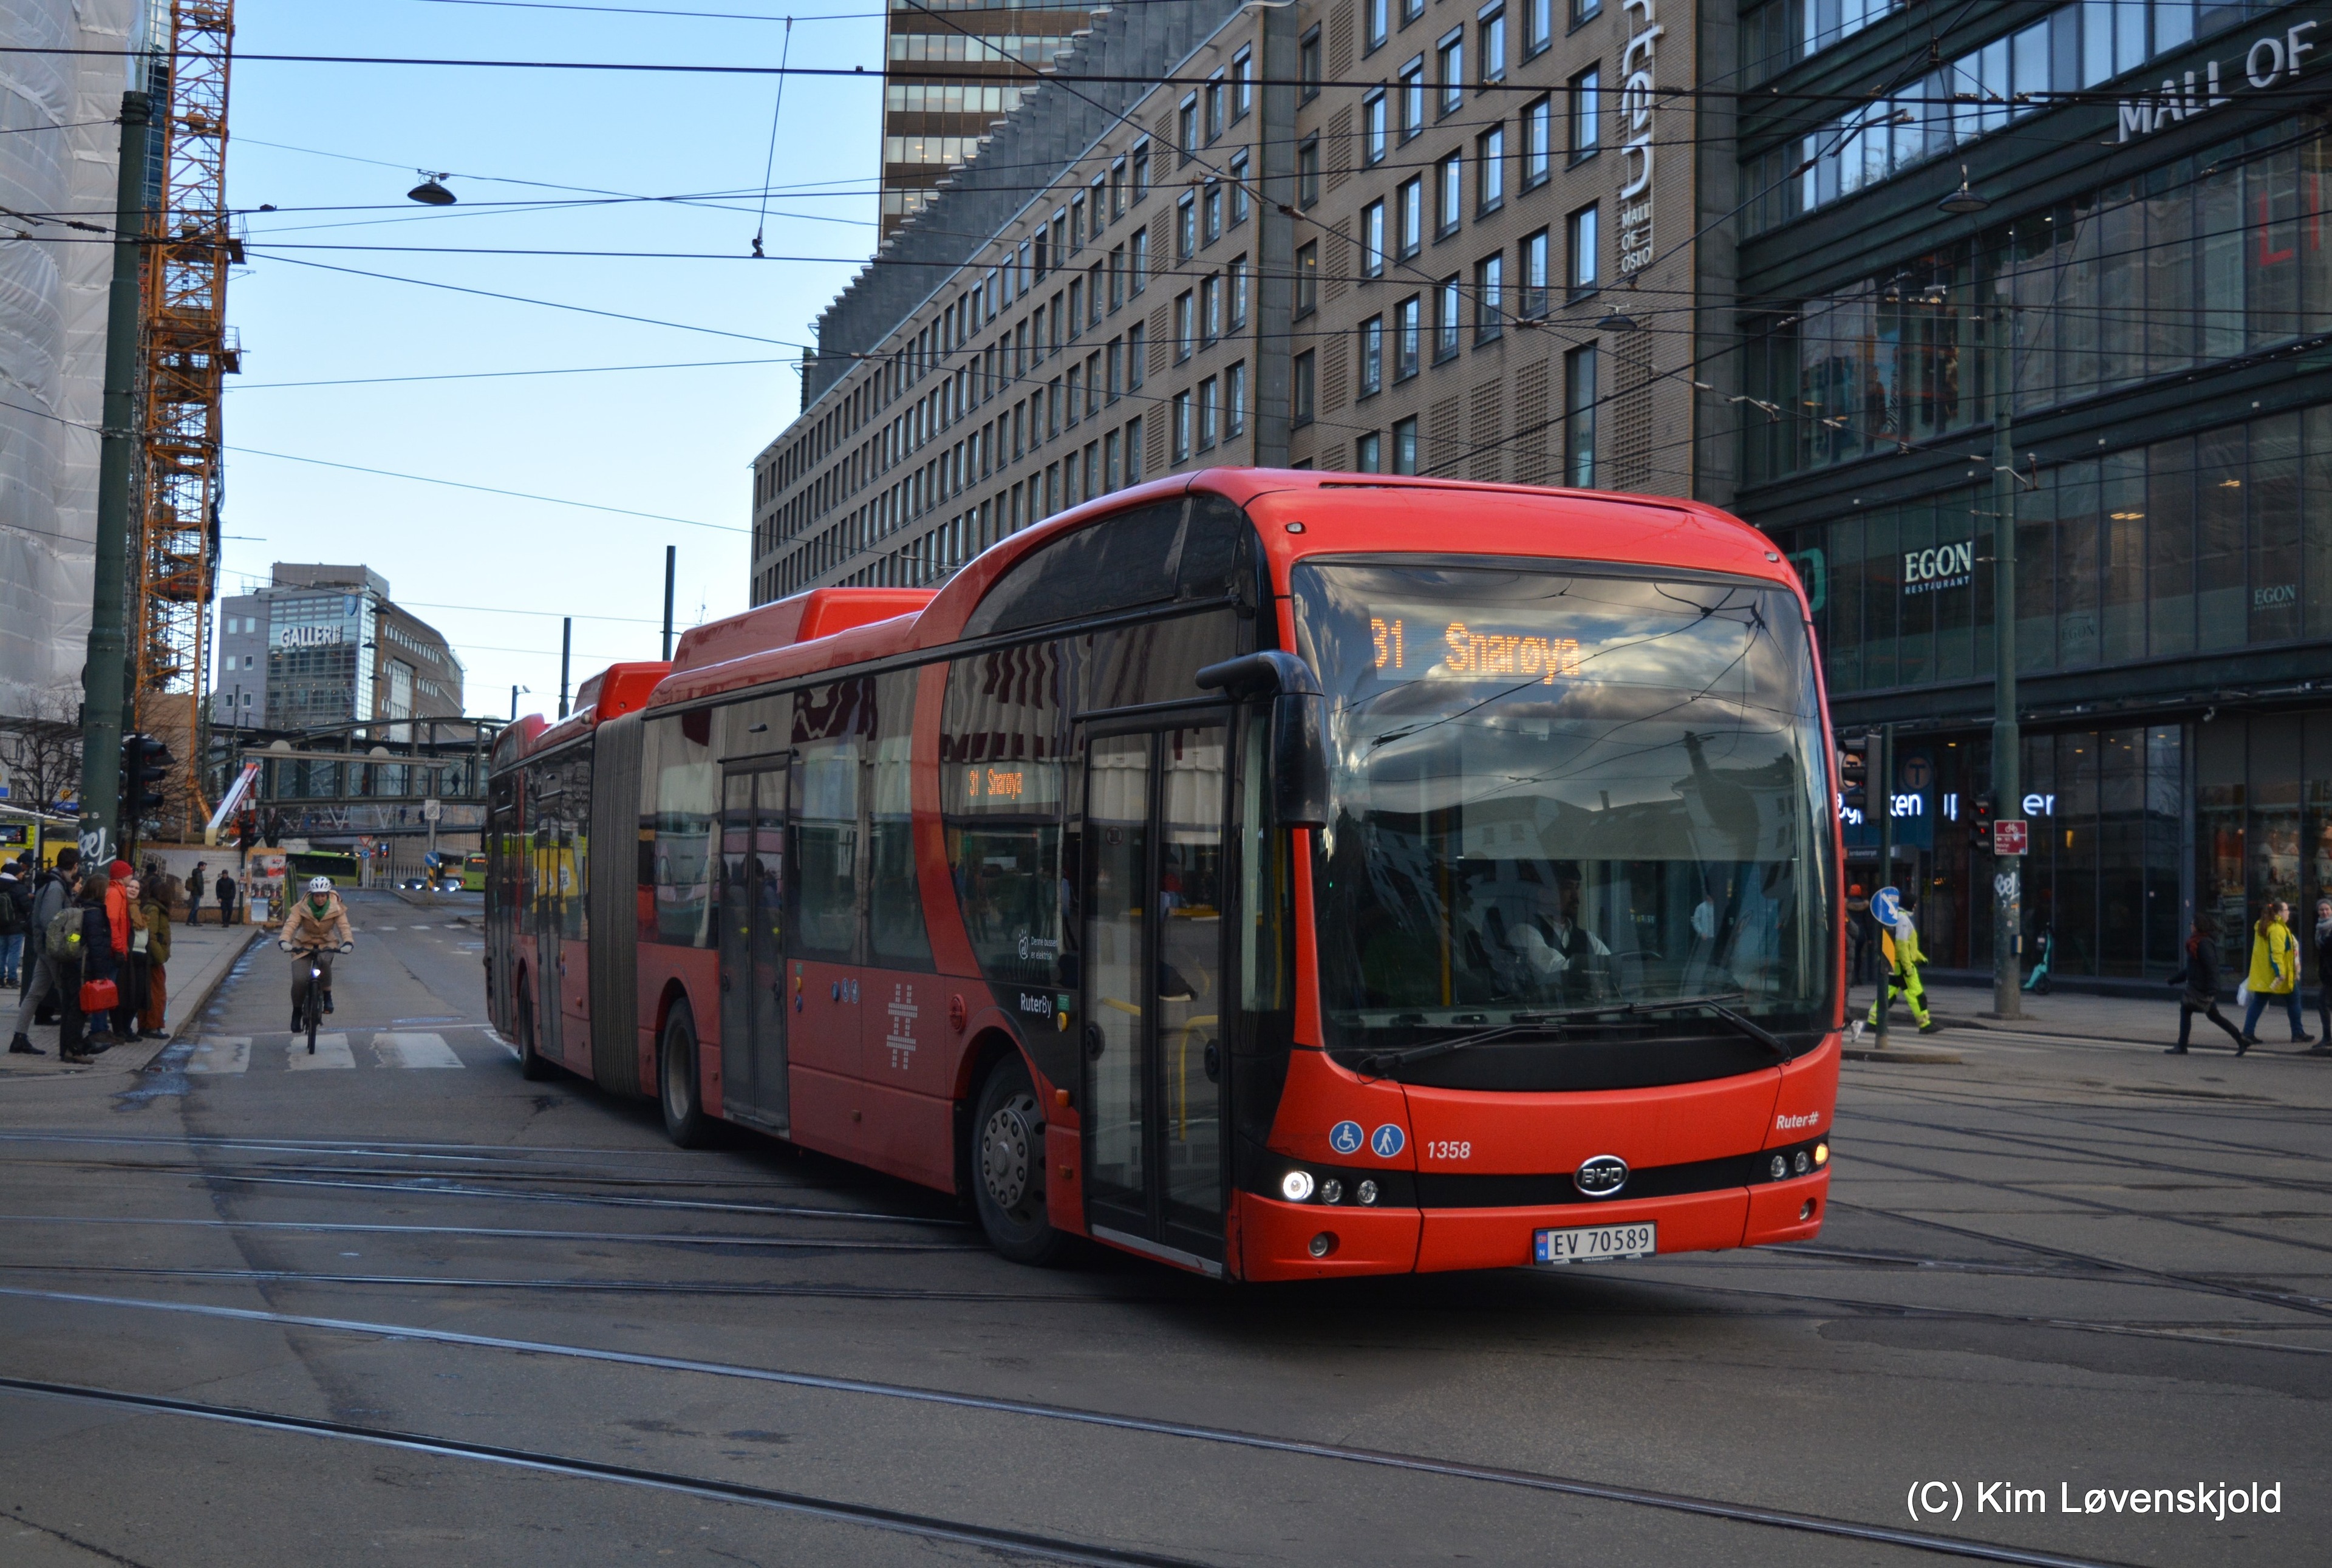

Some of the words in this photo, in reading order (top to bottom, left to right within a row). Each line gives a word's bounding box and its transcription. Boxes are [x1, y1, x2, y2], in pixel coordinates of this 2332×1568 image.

[2119, 61, 2232, 143] MALL
[2246, 21, 2317, 88] OF
[1622, 203, 1651, 229] MALL
[1622, 247, 1651, 272] OSLO
[1904, 541, 1972, 582] EGON
[1904, 575, 1969, 595] RESTAURANT
[2254, 584, 2296, 605] EGON
[280, 624, 335, 648] GALLERI
[1371, 618, 1402, 668] 31
[1445, 622, 1579, 685] Snarøya
[969, 769, 979, 796] 31
[1031, 936, 1044, 946] Denne
[1044, 938, 1059, 947] bussen
[1035, 950, 1052, 960] elektrisk
[1021, 992, 1052, 1018] RuterBy
[1427, 1141, 1471, 1159] 1358
[1581, 1167, 1623, 1184] BYD
[1554, 1233, 1578, 1255] EV
[1588, 1227, 1649, 1253] 70589
